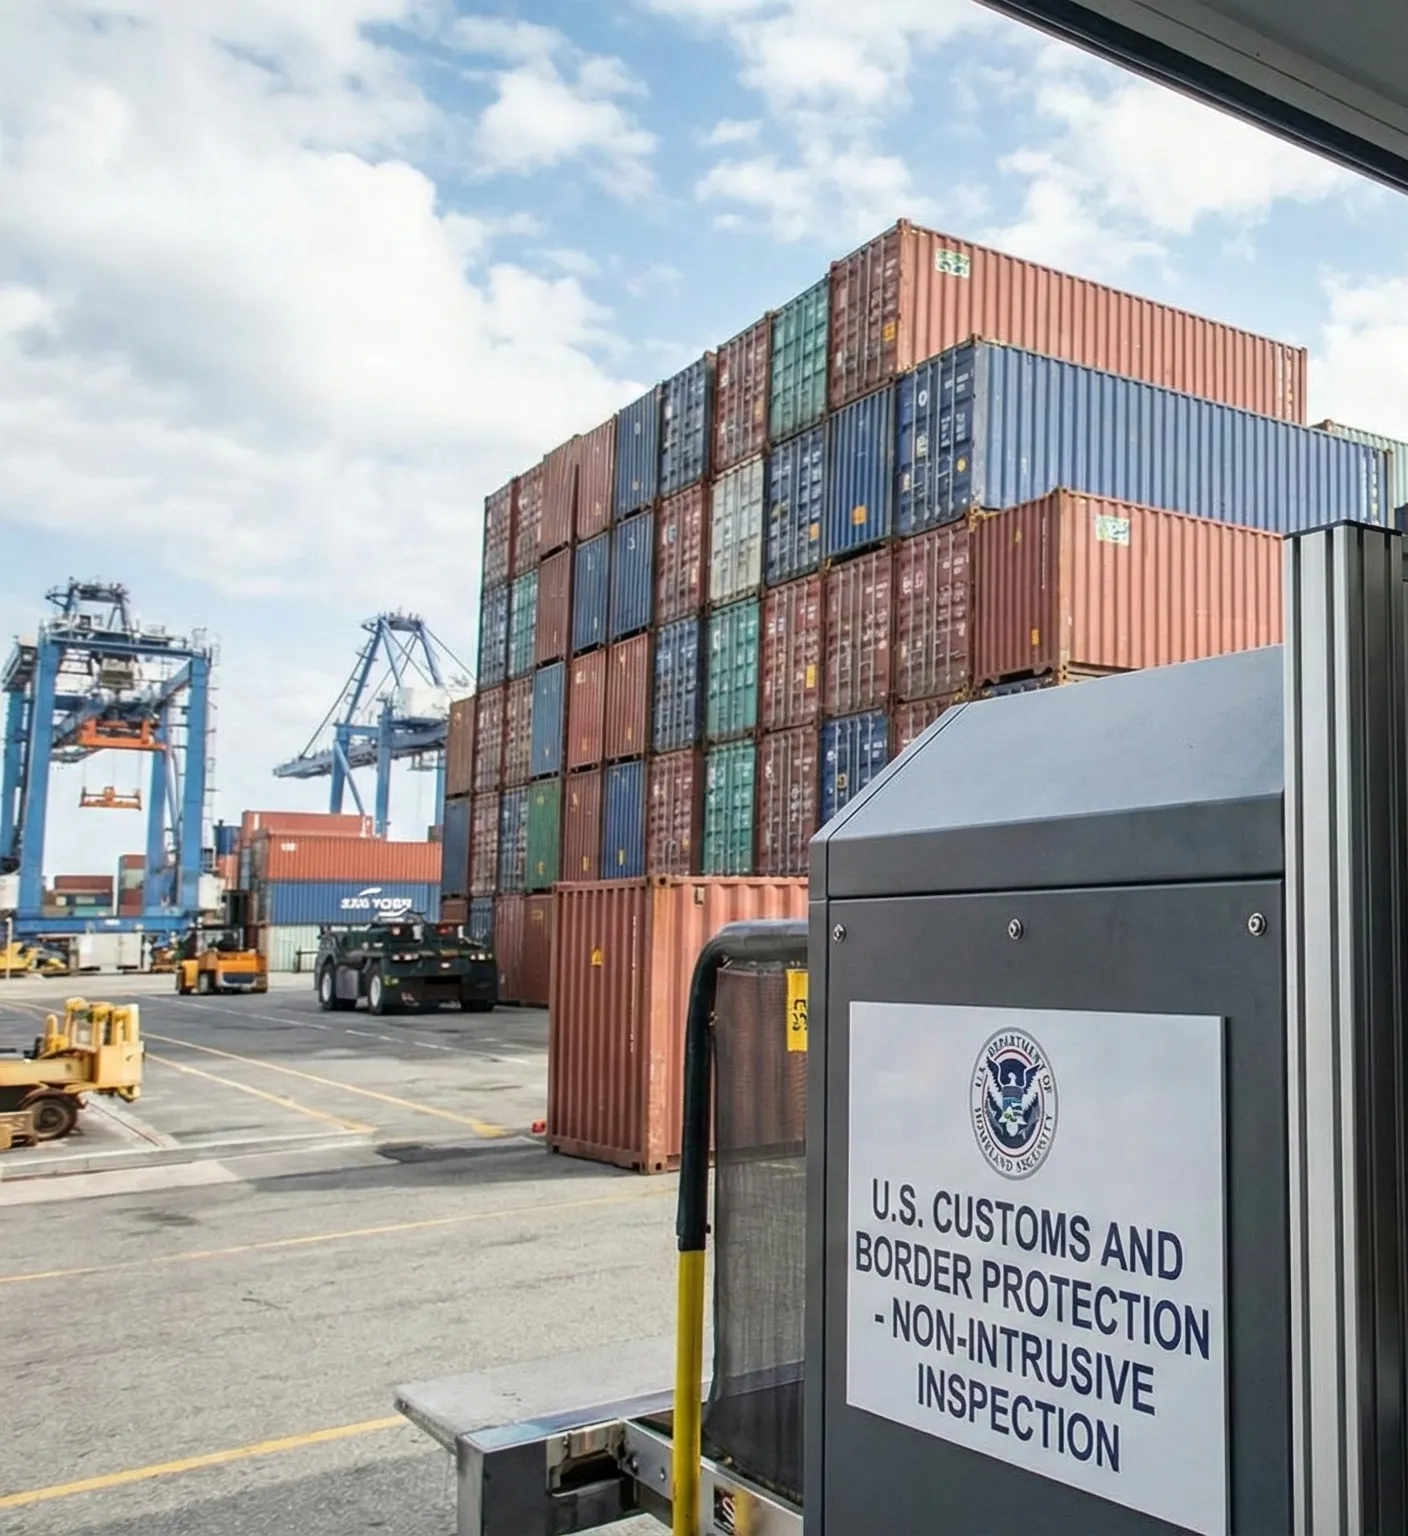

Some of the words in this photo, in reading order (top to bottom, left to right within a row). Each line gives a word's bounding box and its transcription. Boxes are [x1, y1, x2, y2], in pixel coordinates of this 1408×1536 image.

[872, 1178, 923, 1230] U.S.
[933, 1190, 1091, 1263] CUSTOMS
[1100, 1221, 1183, 1281] AND
[855, 1230, 973, 1300] BORDER
[982, 1259, 1210, 1361] PROTECTION
[892, 1297, 1156, 1417] NON-INTRUSIVE
[918, 1362, 1120, 1473] INSPECTION
